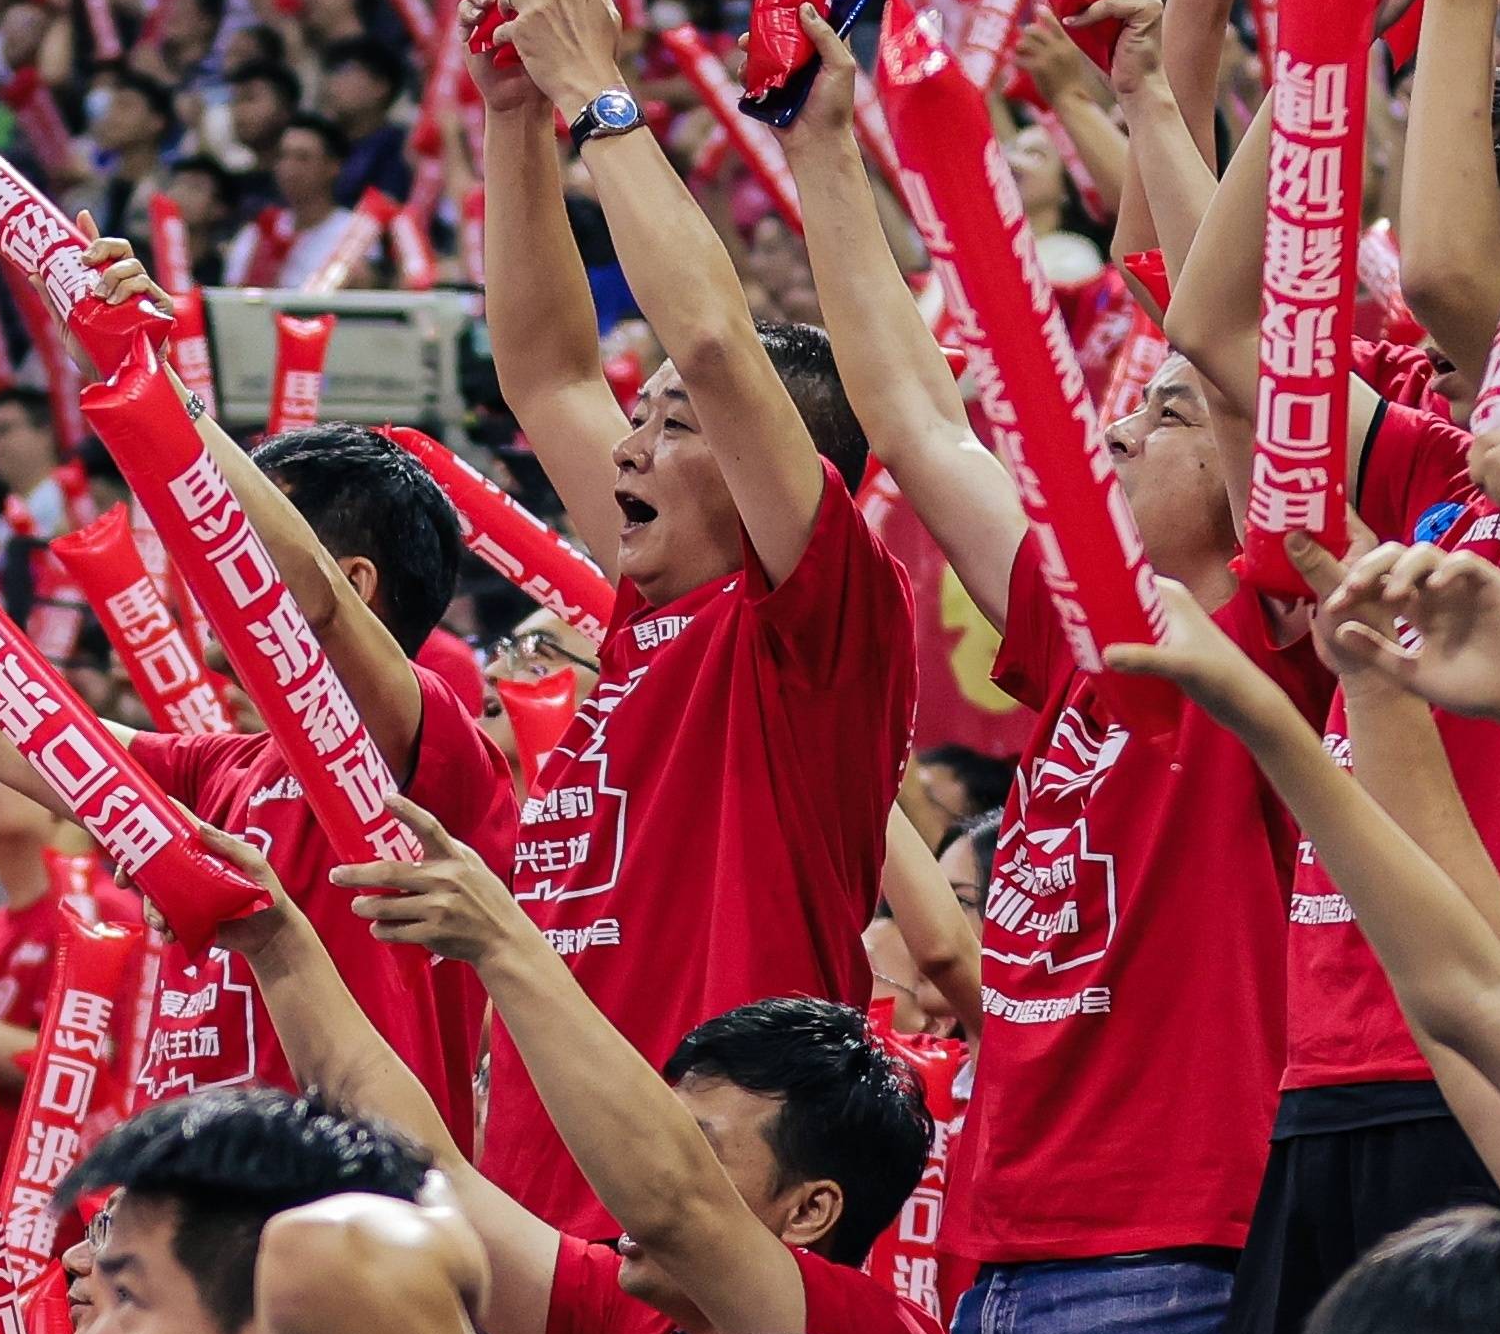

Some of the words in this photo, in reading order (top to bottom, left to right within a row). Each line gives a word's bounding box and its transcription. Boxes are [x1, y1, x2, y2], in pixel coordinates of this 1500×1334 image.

[1246, 50, 1350, 535] 馬可波羅磁磚
[106, 578, 236, 737] 馬可波
